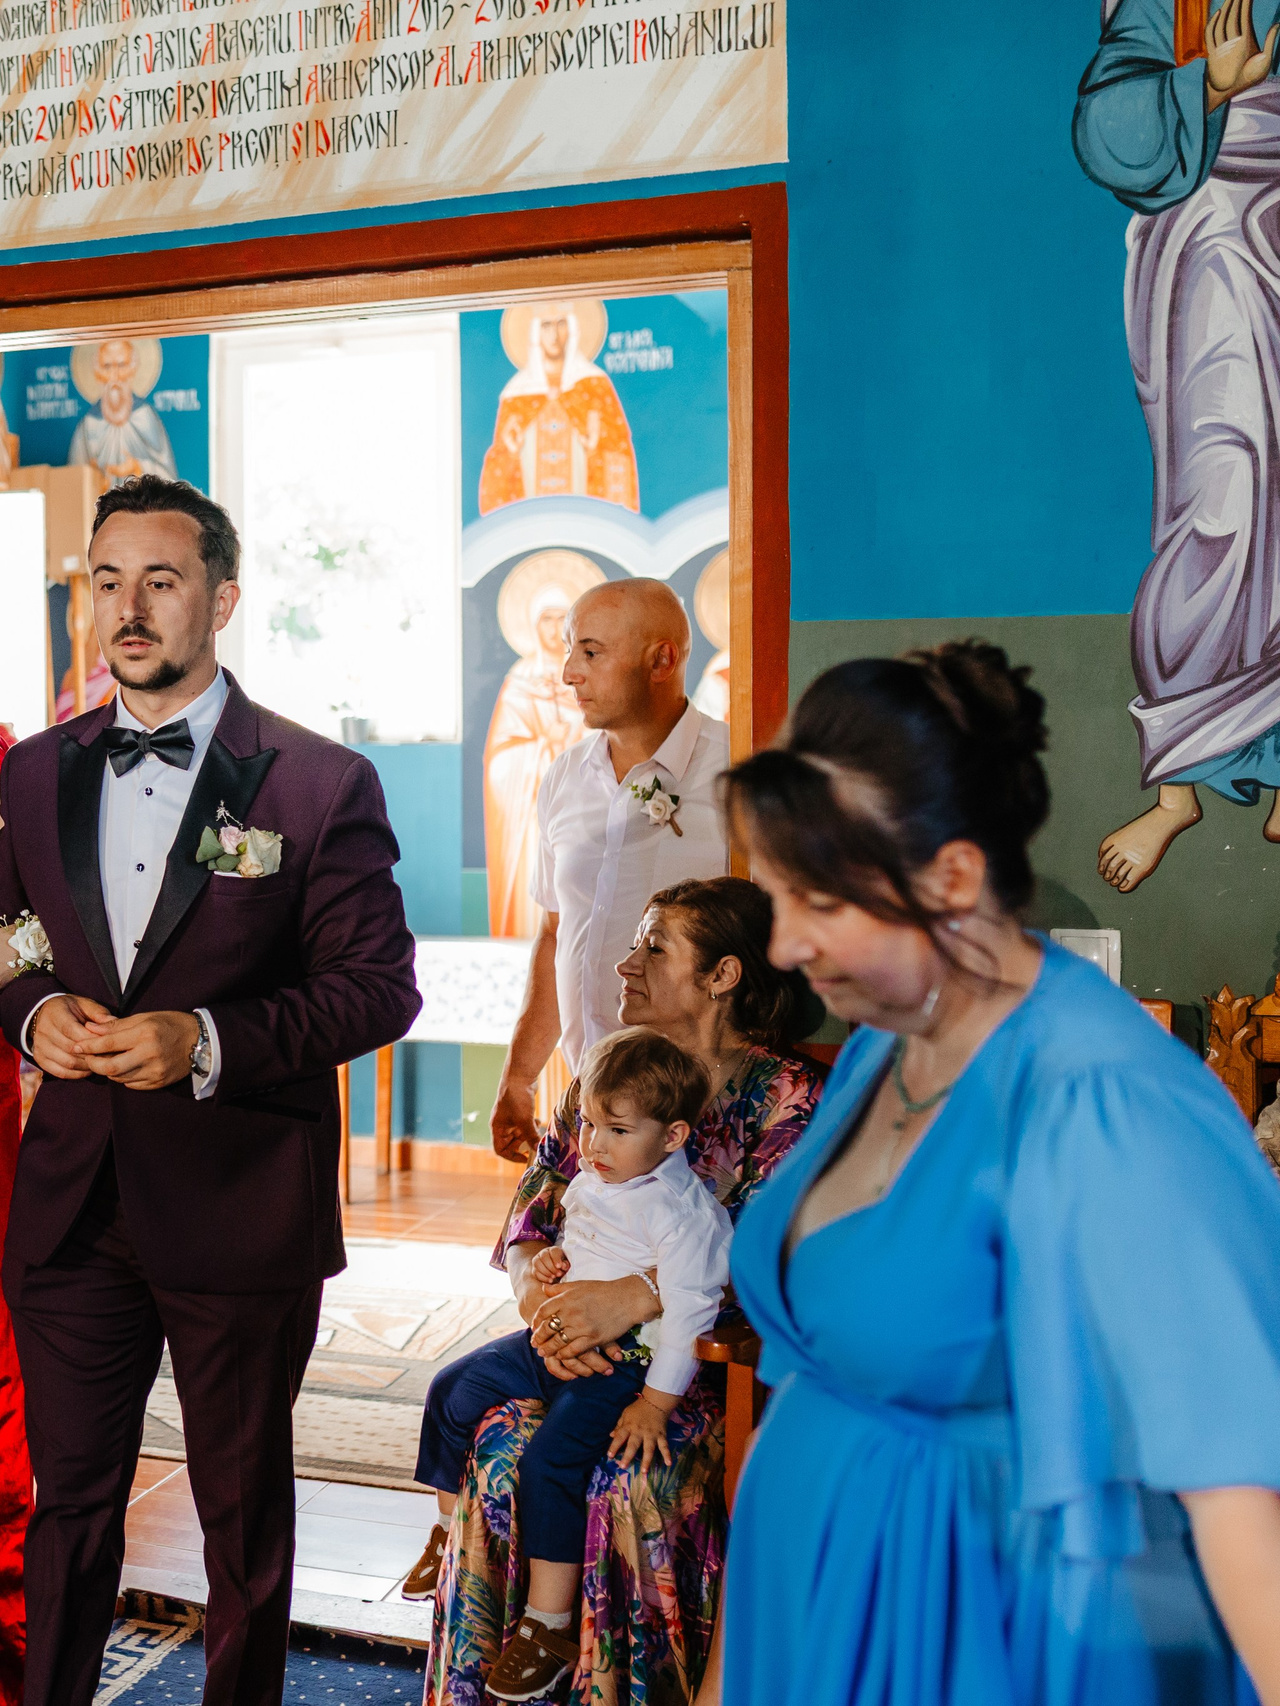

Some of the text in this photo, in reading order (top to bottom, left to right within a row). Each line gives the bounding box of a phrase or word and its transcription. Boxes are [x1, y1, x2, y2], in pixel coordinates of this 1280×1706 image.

[34, 100, 77, 143] 2019
[77, 96, 107, 137] DE
[211, 67, 302, 118] IOACHIM
[633, 2, 775, 64] ROMANULUI
[70, 151, 93, 191] CU
[96, 147, 125, 188] UN
[186, 135, 213, 176] DE
